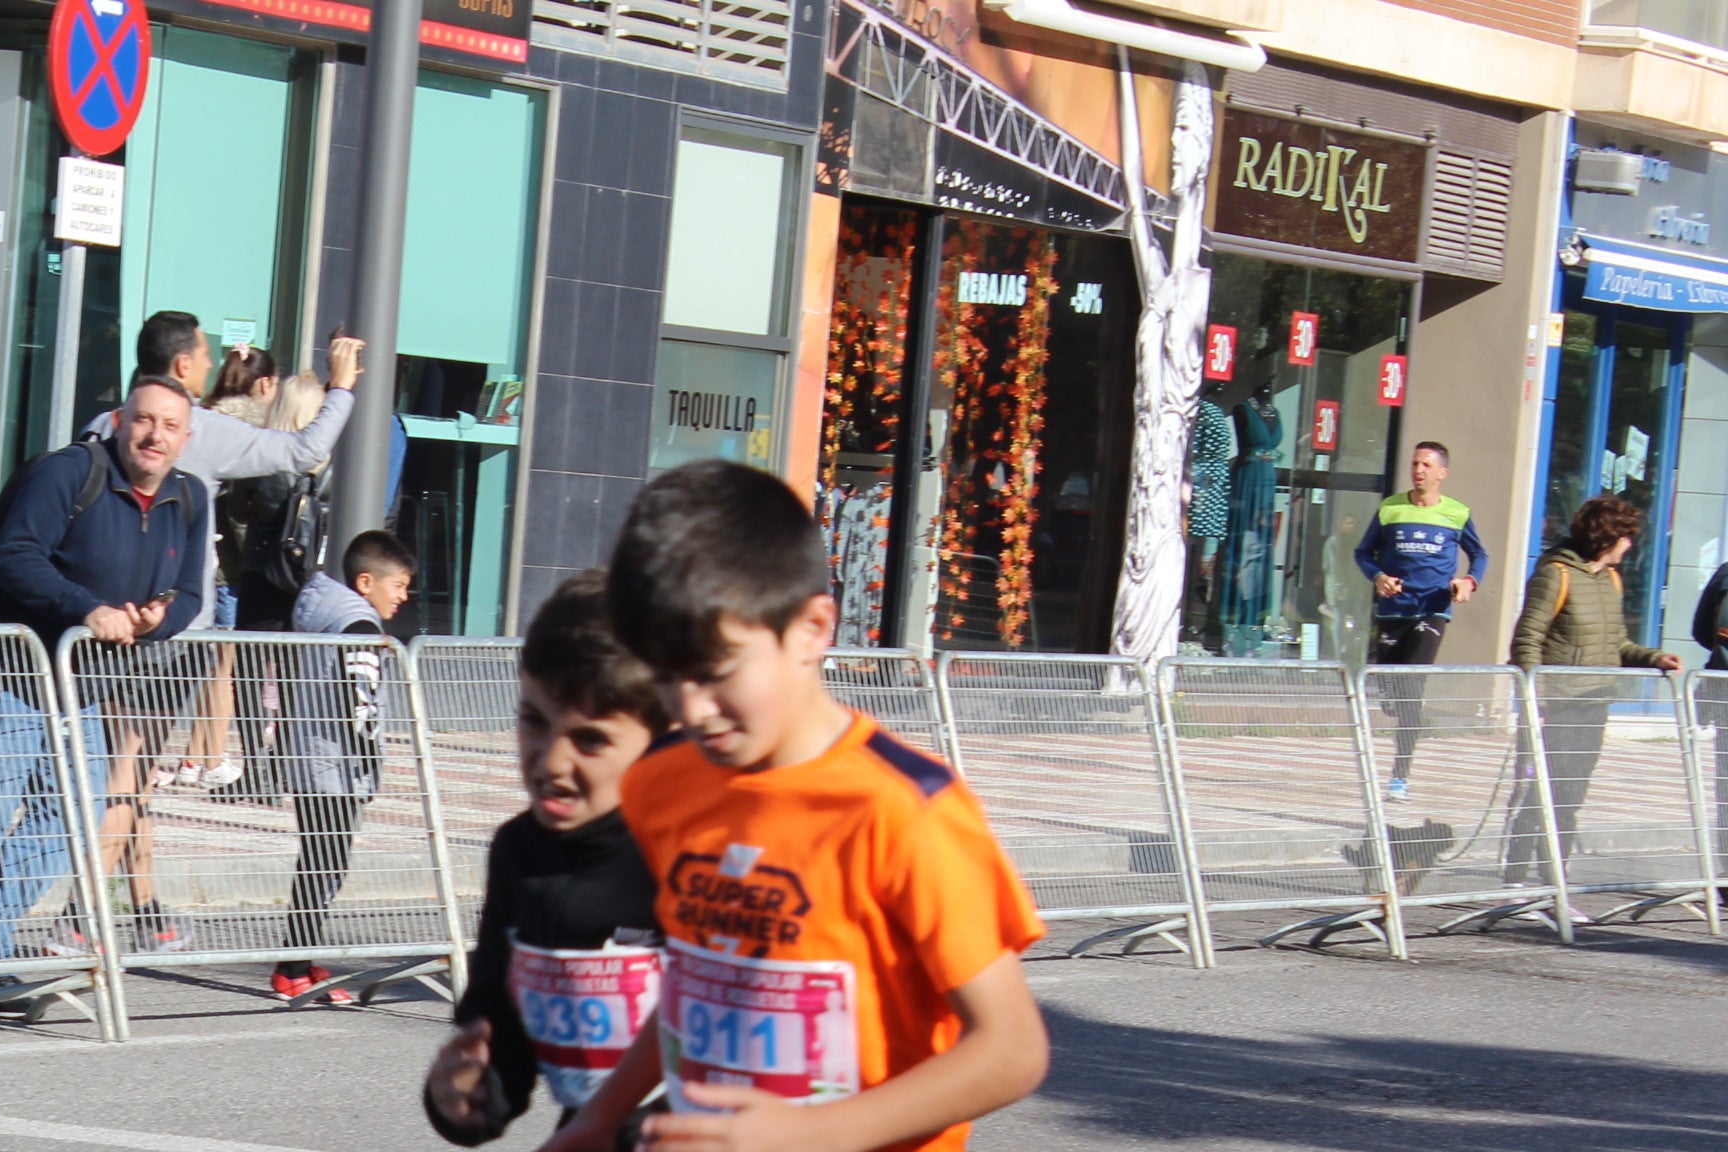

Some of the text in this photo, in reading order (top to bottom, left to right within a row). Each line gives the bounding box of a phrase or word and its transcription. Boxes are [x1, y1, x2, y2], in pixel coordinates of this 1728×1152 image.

[1233, 136, 1391, 243] RADIKAL
[957, 271, 1028, 307] REBAJAS
[669, 389, 757, 433] TAQUILLA
[688, 872, 787, 912] SUPER
[676, 901, 800, 945] RUNNER
[524, 988, 613, 1044] 939
[688, 1002, 777, 1067] 911
